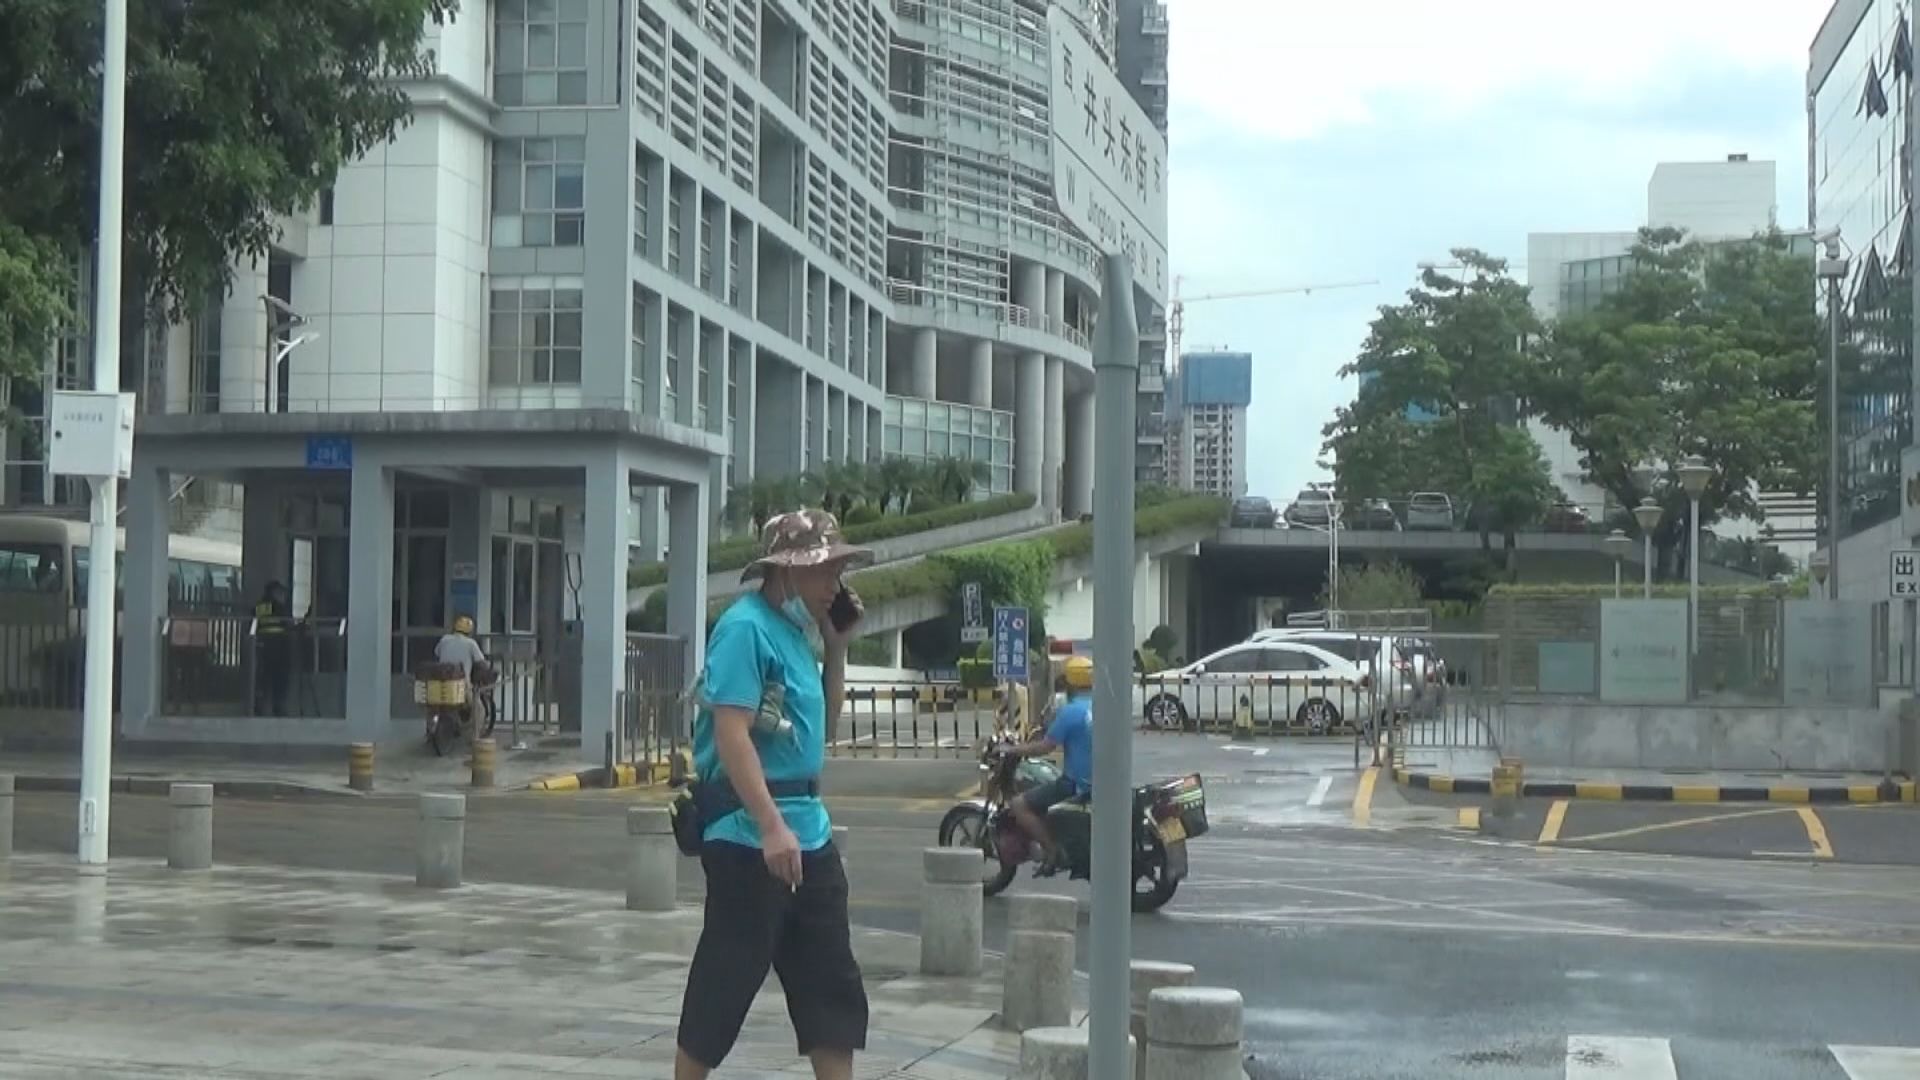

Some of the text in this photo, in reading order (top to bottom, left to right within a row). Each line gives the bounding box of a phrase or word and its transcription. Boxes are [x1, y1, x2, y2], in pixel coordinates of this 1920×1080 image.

[1063, 43, 1073, 93] 西
[1083, 69, 1147, 204] 井头东街
[1066, 165, 1076, 204] W
[1156, 257, 1161, 290] E
[1896, 555, 1915, 575] 出
[1896, 582, 1918, 593] EX
